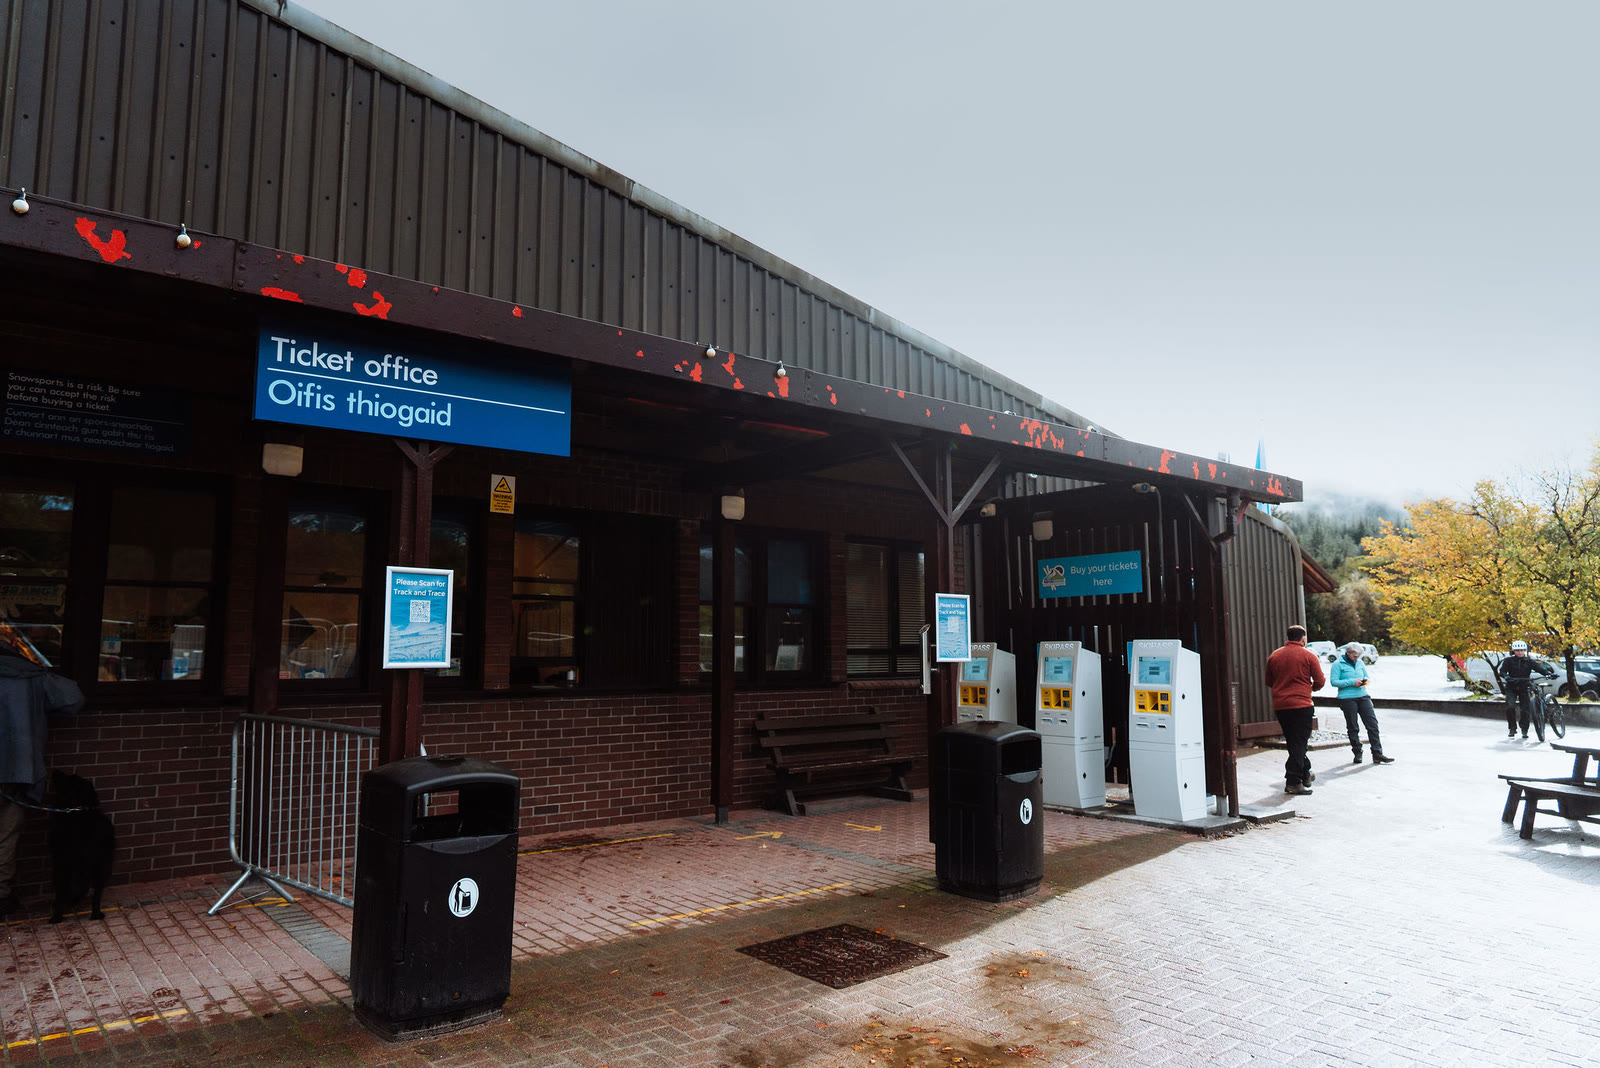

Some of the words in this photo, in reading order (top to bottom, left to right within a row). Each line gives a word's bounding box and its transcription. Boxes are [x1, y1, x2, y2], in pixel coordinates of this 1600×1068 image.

[270, 336, 354, 372] Ticket
[364, 354, 438, 386] office
[8, 372, 64, 386] Snowsports
[67, 380, 74, 388] is
[108, 385, 120, 394] Be
[7, 392, 38, 402] before
[42, 396, 73, 408] buying
[50, 389, 80, 398] accept
[82, 391, 97, 400] the
[100, 394, 116, 402] risk
[268, 379, 336, 410] Oifis
[346, 390, 452, 428] thiogaid
[6, 408, 45, 418] Cunnart
[16, 429, 58, 439] chunnart
[1070, 566, 1086, 575] Buy
[1088, 565, 1106, 574] your
[1108, 562, 1138, 571] tickets
[1093, 578, 1113, 586] here
